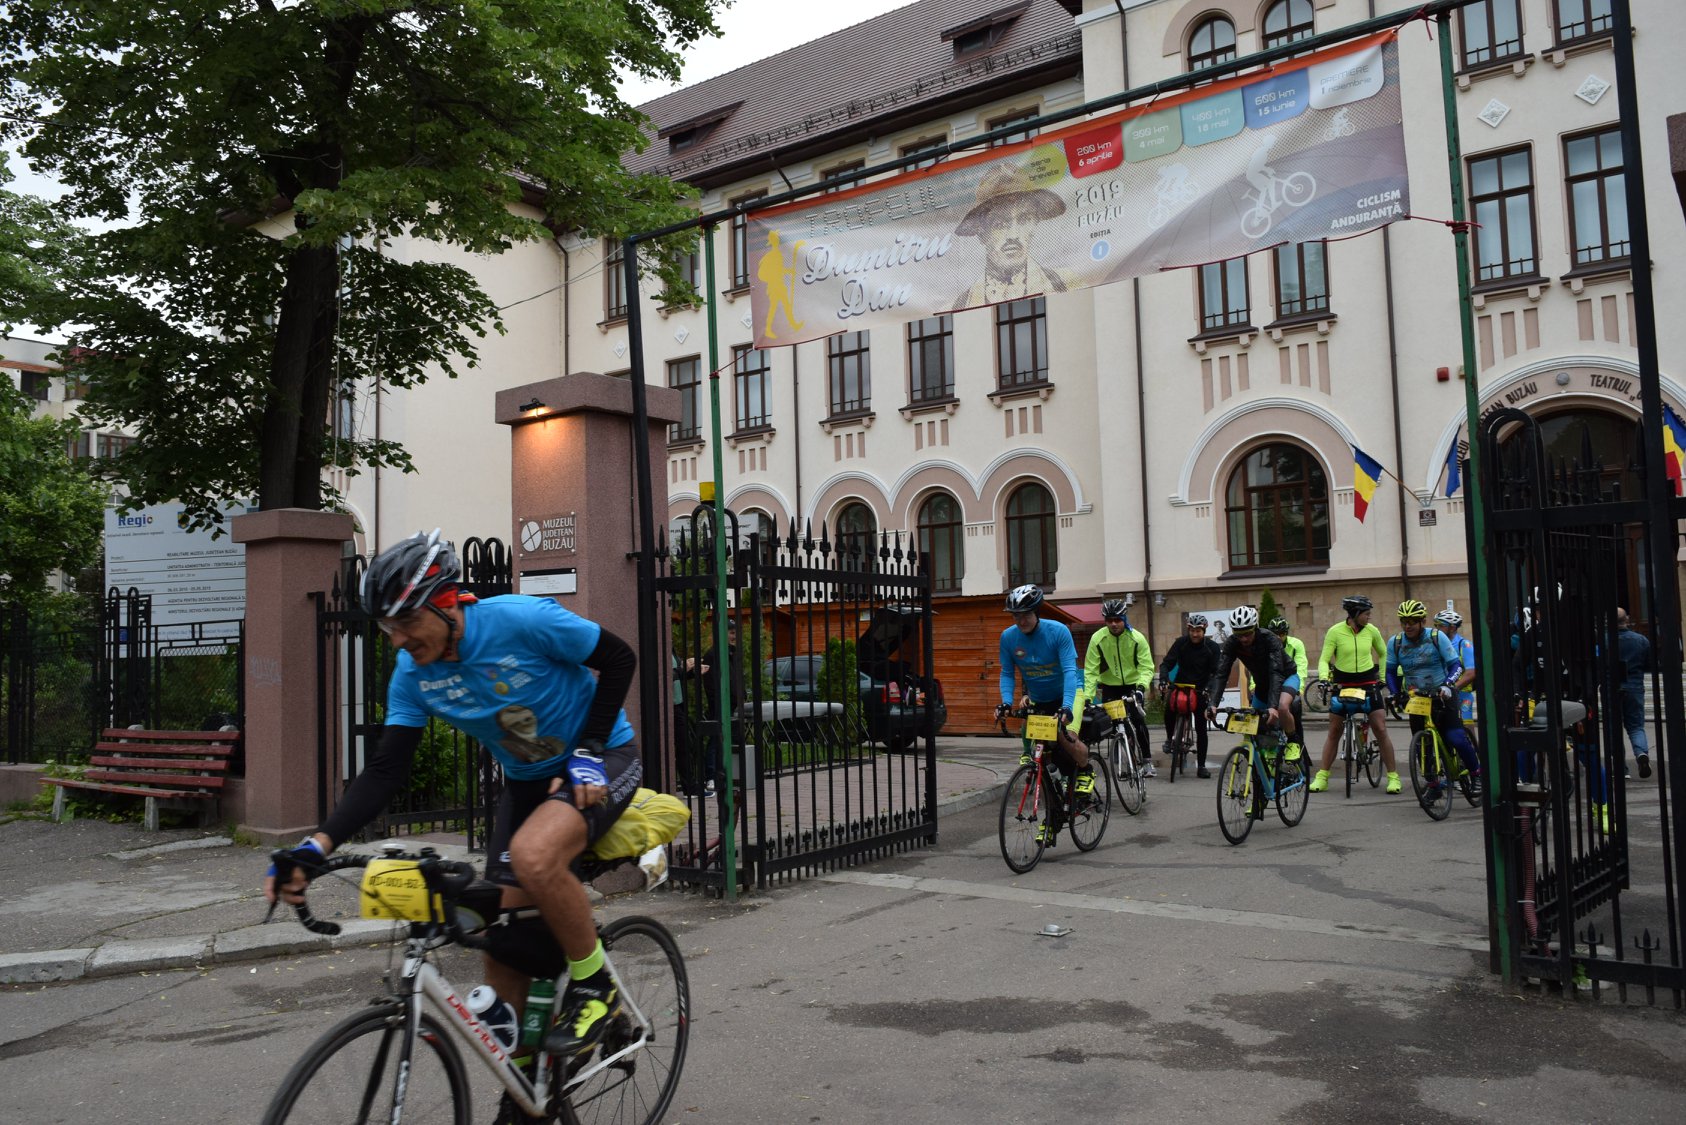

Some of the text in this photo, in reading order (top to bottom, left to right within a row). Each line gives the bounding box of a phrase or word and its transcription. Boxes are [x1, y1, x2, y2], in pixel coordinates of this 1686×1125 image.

[1255, 87, 1295, 106] 600 km
[1258, 106, 1270, 117] 15
[1153, 123, 1169, 134] km
[1211, 119, 1229, 131] mai
[1076, 140, 1112, 157] 200 km
[1139, 135, 1165, 149] 4 mai
[1078, 150, 1113, 167] 6 aprilie
[1075, 180, 1125, 208] 2019
[1356, 189, 1401, 209] CICLISM
[805, 184, 950, 238] TROFEUL
[802, 232, 952, 285] Dumitru
[837, 276, 913, 319] Dan
[1590, 374, 1632, 395] TEATRUL
[118, 513, 153, 528] Regio
[542, 517, 575, 529] MUZEUL
